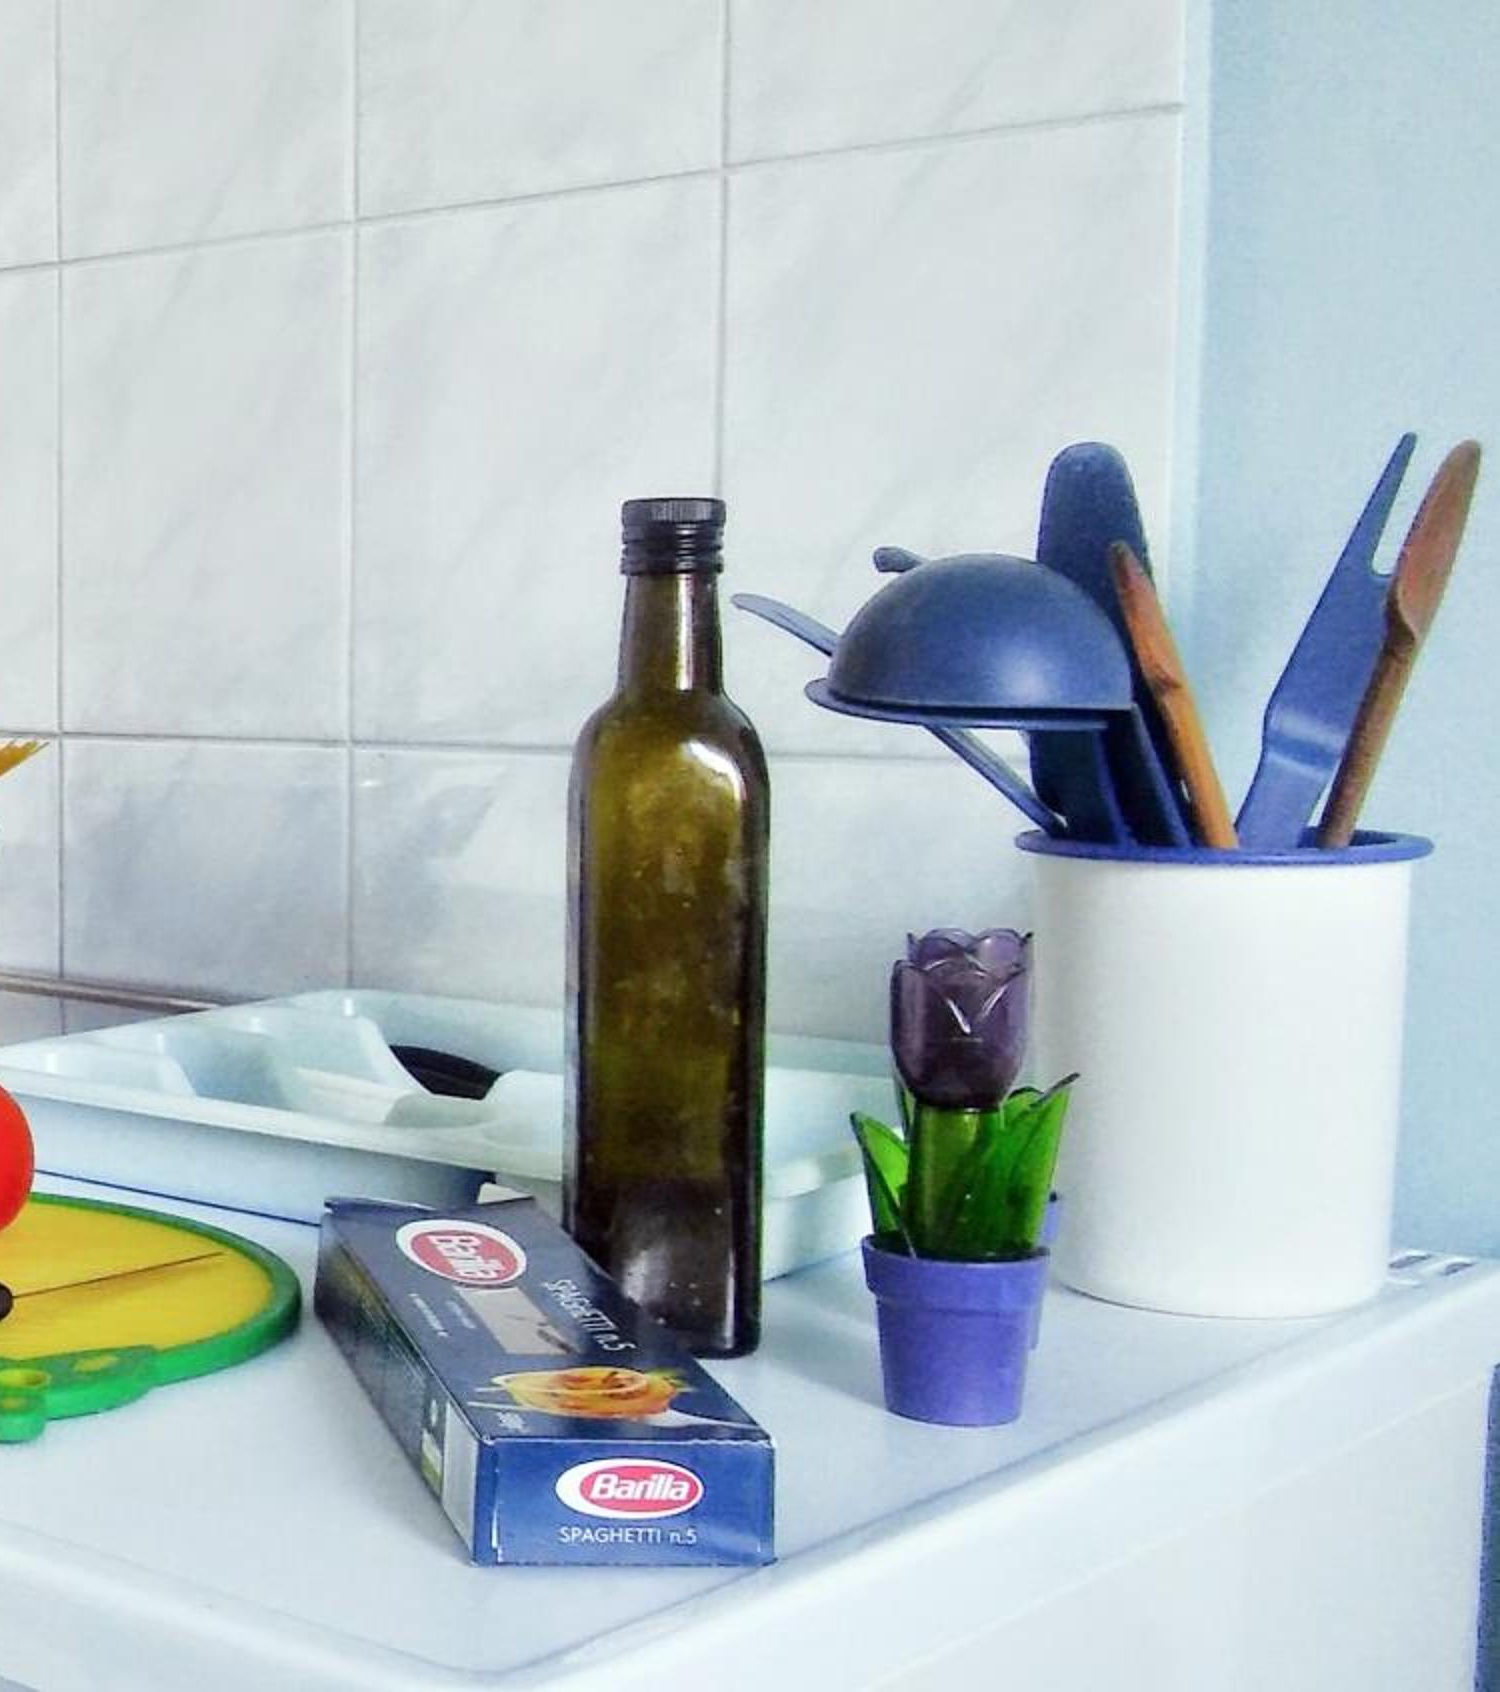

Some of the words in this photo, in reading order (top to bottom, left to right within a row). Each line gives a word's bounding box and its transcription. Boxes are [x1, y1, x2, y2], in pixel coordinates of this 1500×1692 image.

[589, 1472, 690, 1501] Barilla
[559, 1526, 661, 1544] SPAGHETTI
[669, 1527, 697, 1545] n.5
